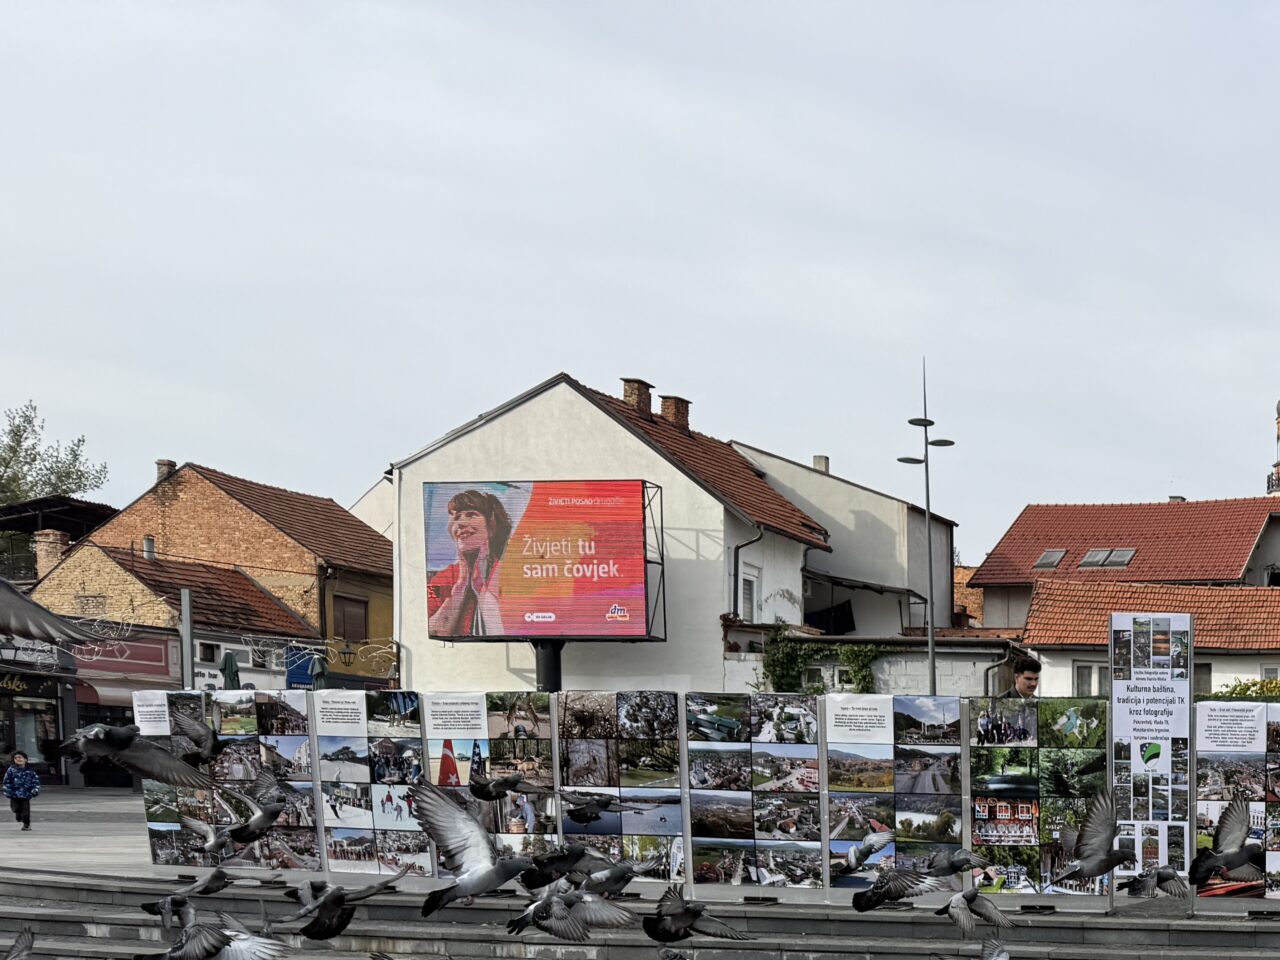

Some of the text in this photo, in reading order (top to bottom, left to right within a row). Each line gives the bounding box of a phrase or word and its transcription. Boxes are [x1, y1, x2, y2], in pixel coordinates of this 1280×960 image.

[522, 535, 595, 559] Živjeti tu
[523, 560, 624, 582] sam čovjek.
[610, 605, 626, 615] dm
[1126, 684, 1176, 694] Kulturna baština,
[1117, 697, 1142, 706] tradicija
[1146, 697, 1177, 706] potencijali
[1177, 697, 1186, 705] TK
[1129, 708, 1174, 718] kroz fotografiju
